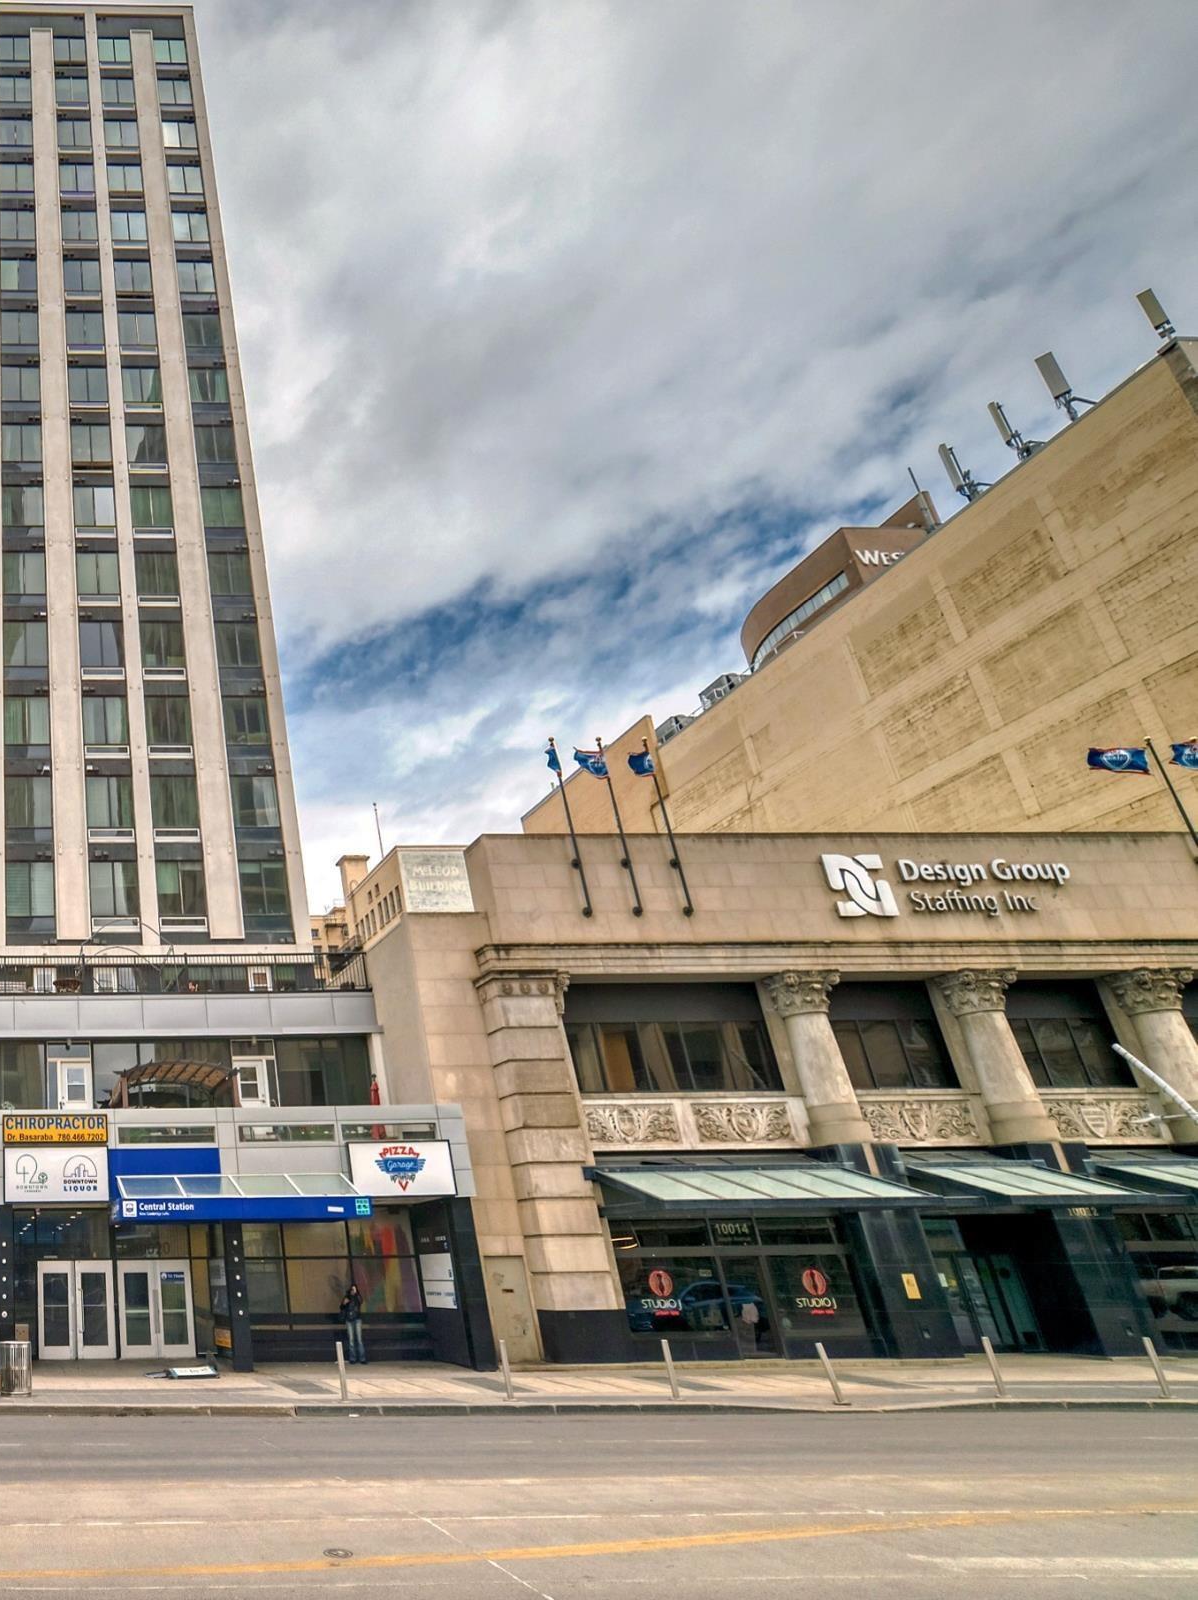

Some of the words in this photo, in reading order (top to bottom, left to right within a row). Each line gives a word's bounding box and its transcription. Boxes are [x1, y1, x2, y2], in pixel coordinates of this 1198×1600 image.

[855, 549, 905, 565] WES
[897, 858, 987, 886] Design
[990, 858, 1071, 886] Group
[909, 889, 998, 916] Staffing
[1003, 890, 1041, 911] Inc
[5, 1117, 105, 1130] CHIROPRACTOR
[7, 1133, 18, 1141] Dr.
[19, 1133, 53, 1141] Basaraba
[382, 1145, 416, 1156] PIZZA
[387, 1159, 414, 1171] Garage
[139, 1202, 166, 1211] Central
[168, 1202, 195, 1211] Station
[714, 1223, 750, 1235] 10014
[641, 1299, 677, 1309] STUDIO
[795, 1298, 831, 1309] STUDIO
